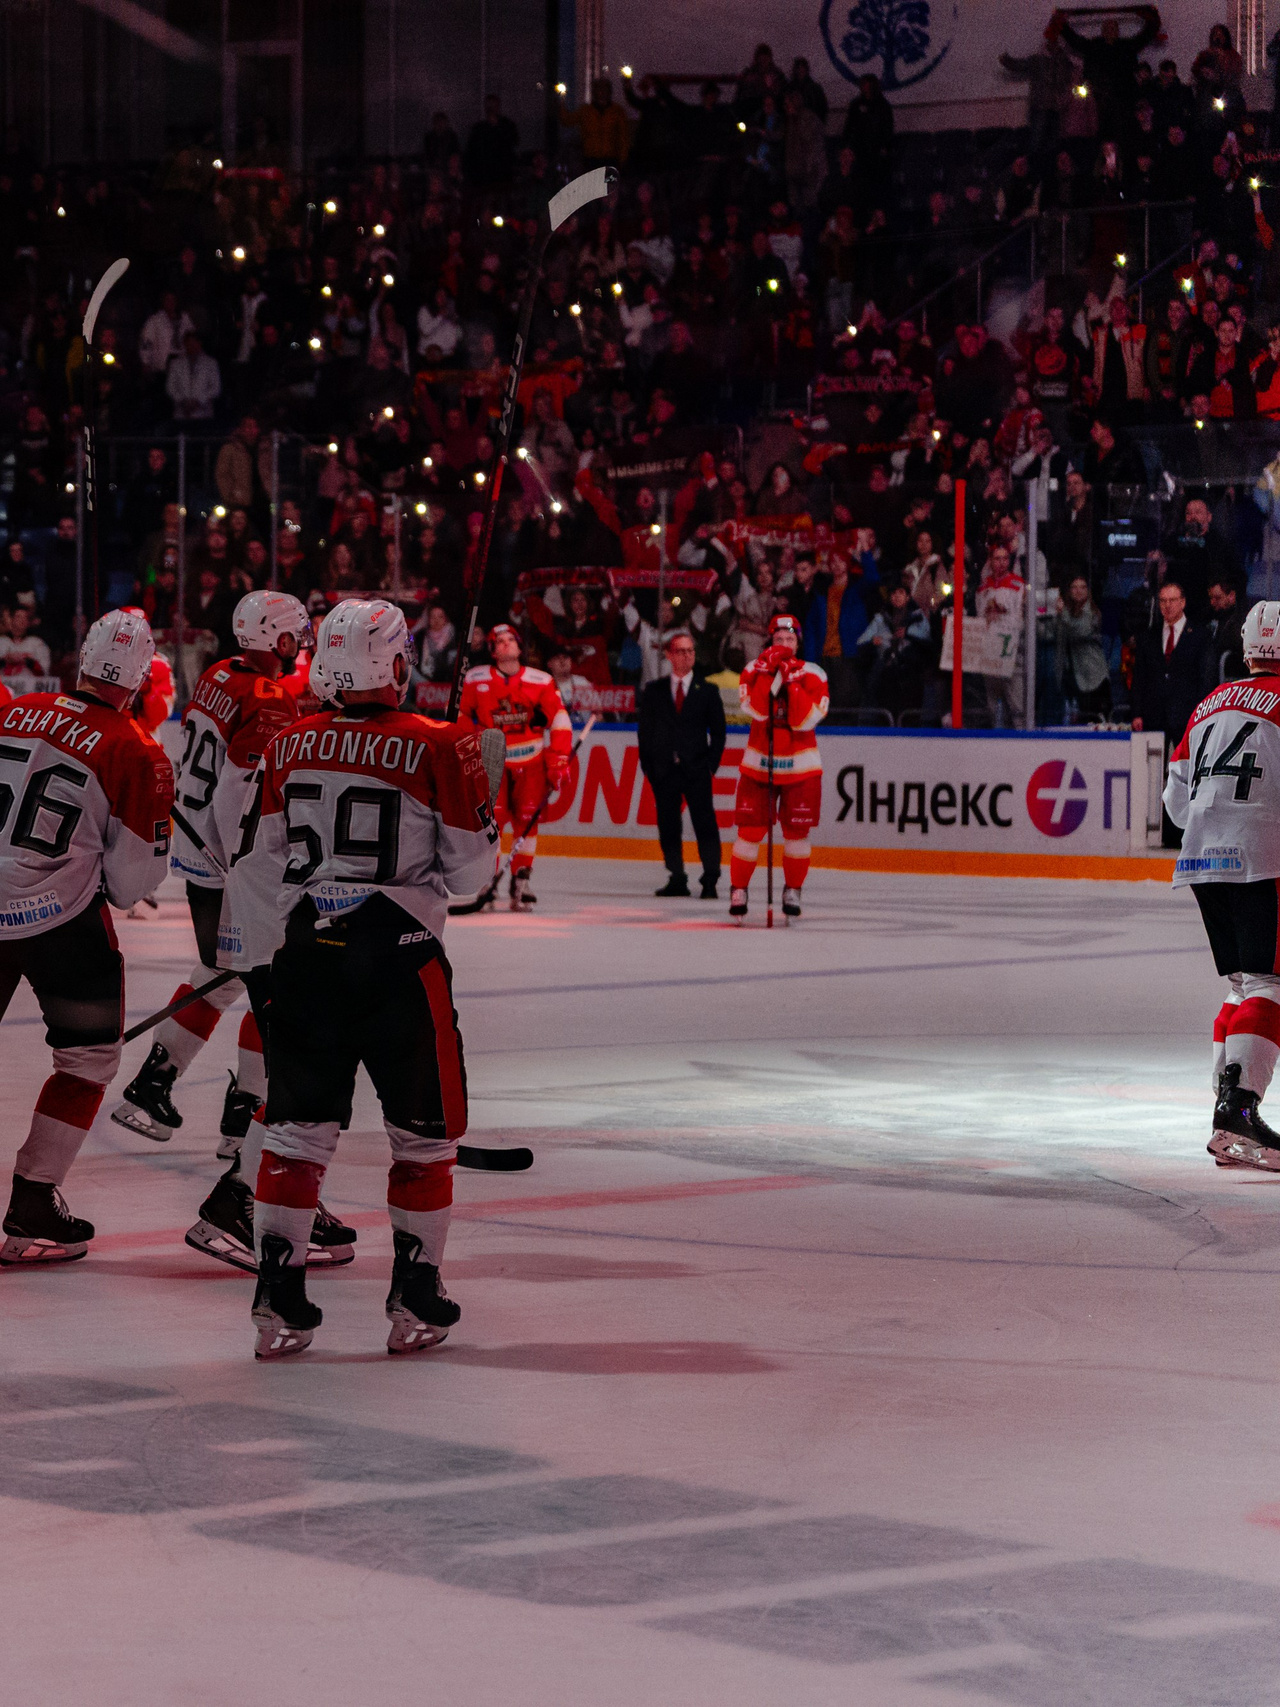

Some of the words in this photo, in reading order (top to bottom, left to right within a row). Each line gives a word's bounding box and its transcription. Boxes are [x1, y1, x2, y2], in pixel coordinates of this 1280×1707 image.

[116, 637, 130, 645] BET
[117, 631, 132, 640] FON
[329, 640, 344, 648] BET
[330, 633, 344, 641] FON
[1258, 645, 1275, 658] 44
[100, 662, 122, 682] 56
[332, 671, 355, 689] 59
[4, 706, 103, 755] CHAYKA
[274, 729, 427, 775] VORONKOV
[1190, 721, 1263, 801] 44
[836, 765, 1013, 833] Яндекс
[282, 782, 402, 886] 59
[320, 886, 349, 896] СЕТЬ
[10, 898, 36, 910] СЕТЬ
[38, 892, 57, 904] АЗС
